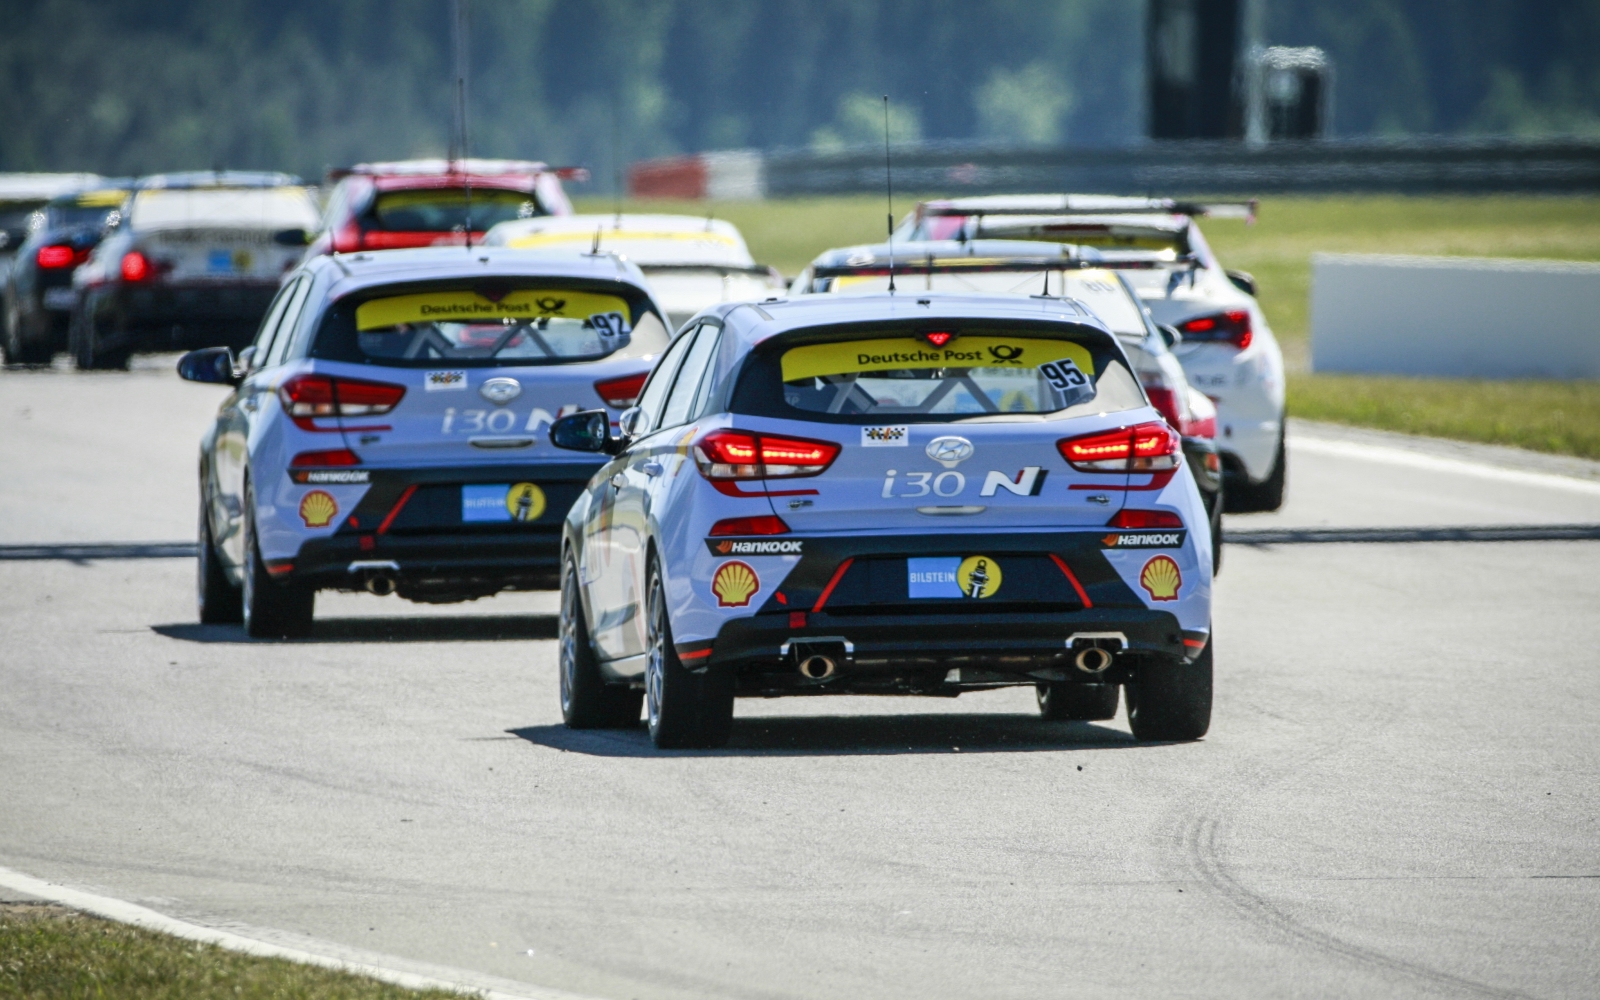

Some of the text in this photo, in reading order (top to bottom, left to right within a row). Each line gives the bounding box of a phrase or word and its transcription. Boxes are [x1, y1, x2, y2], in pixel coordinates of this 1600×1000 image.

[421, 302, 531, 314] Deutsche Post
[593, 313, 629, 337] 92
[857, 350, 983, 365] Deutsche Post
[1041, 358, 1086, 389] 95
[441, 407, 516, 434] i30
[882, 466, 1049, 498] i30 N
[910, 572, 955, 583] BILSTEIN
